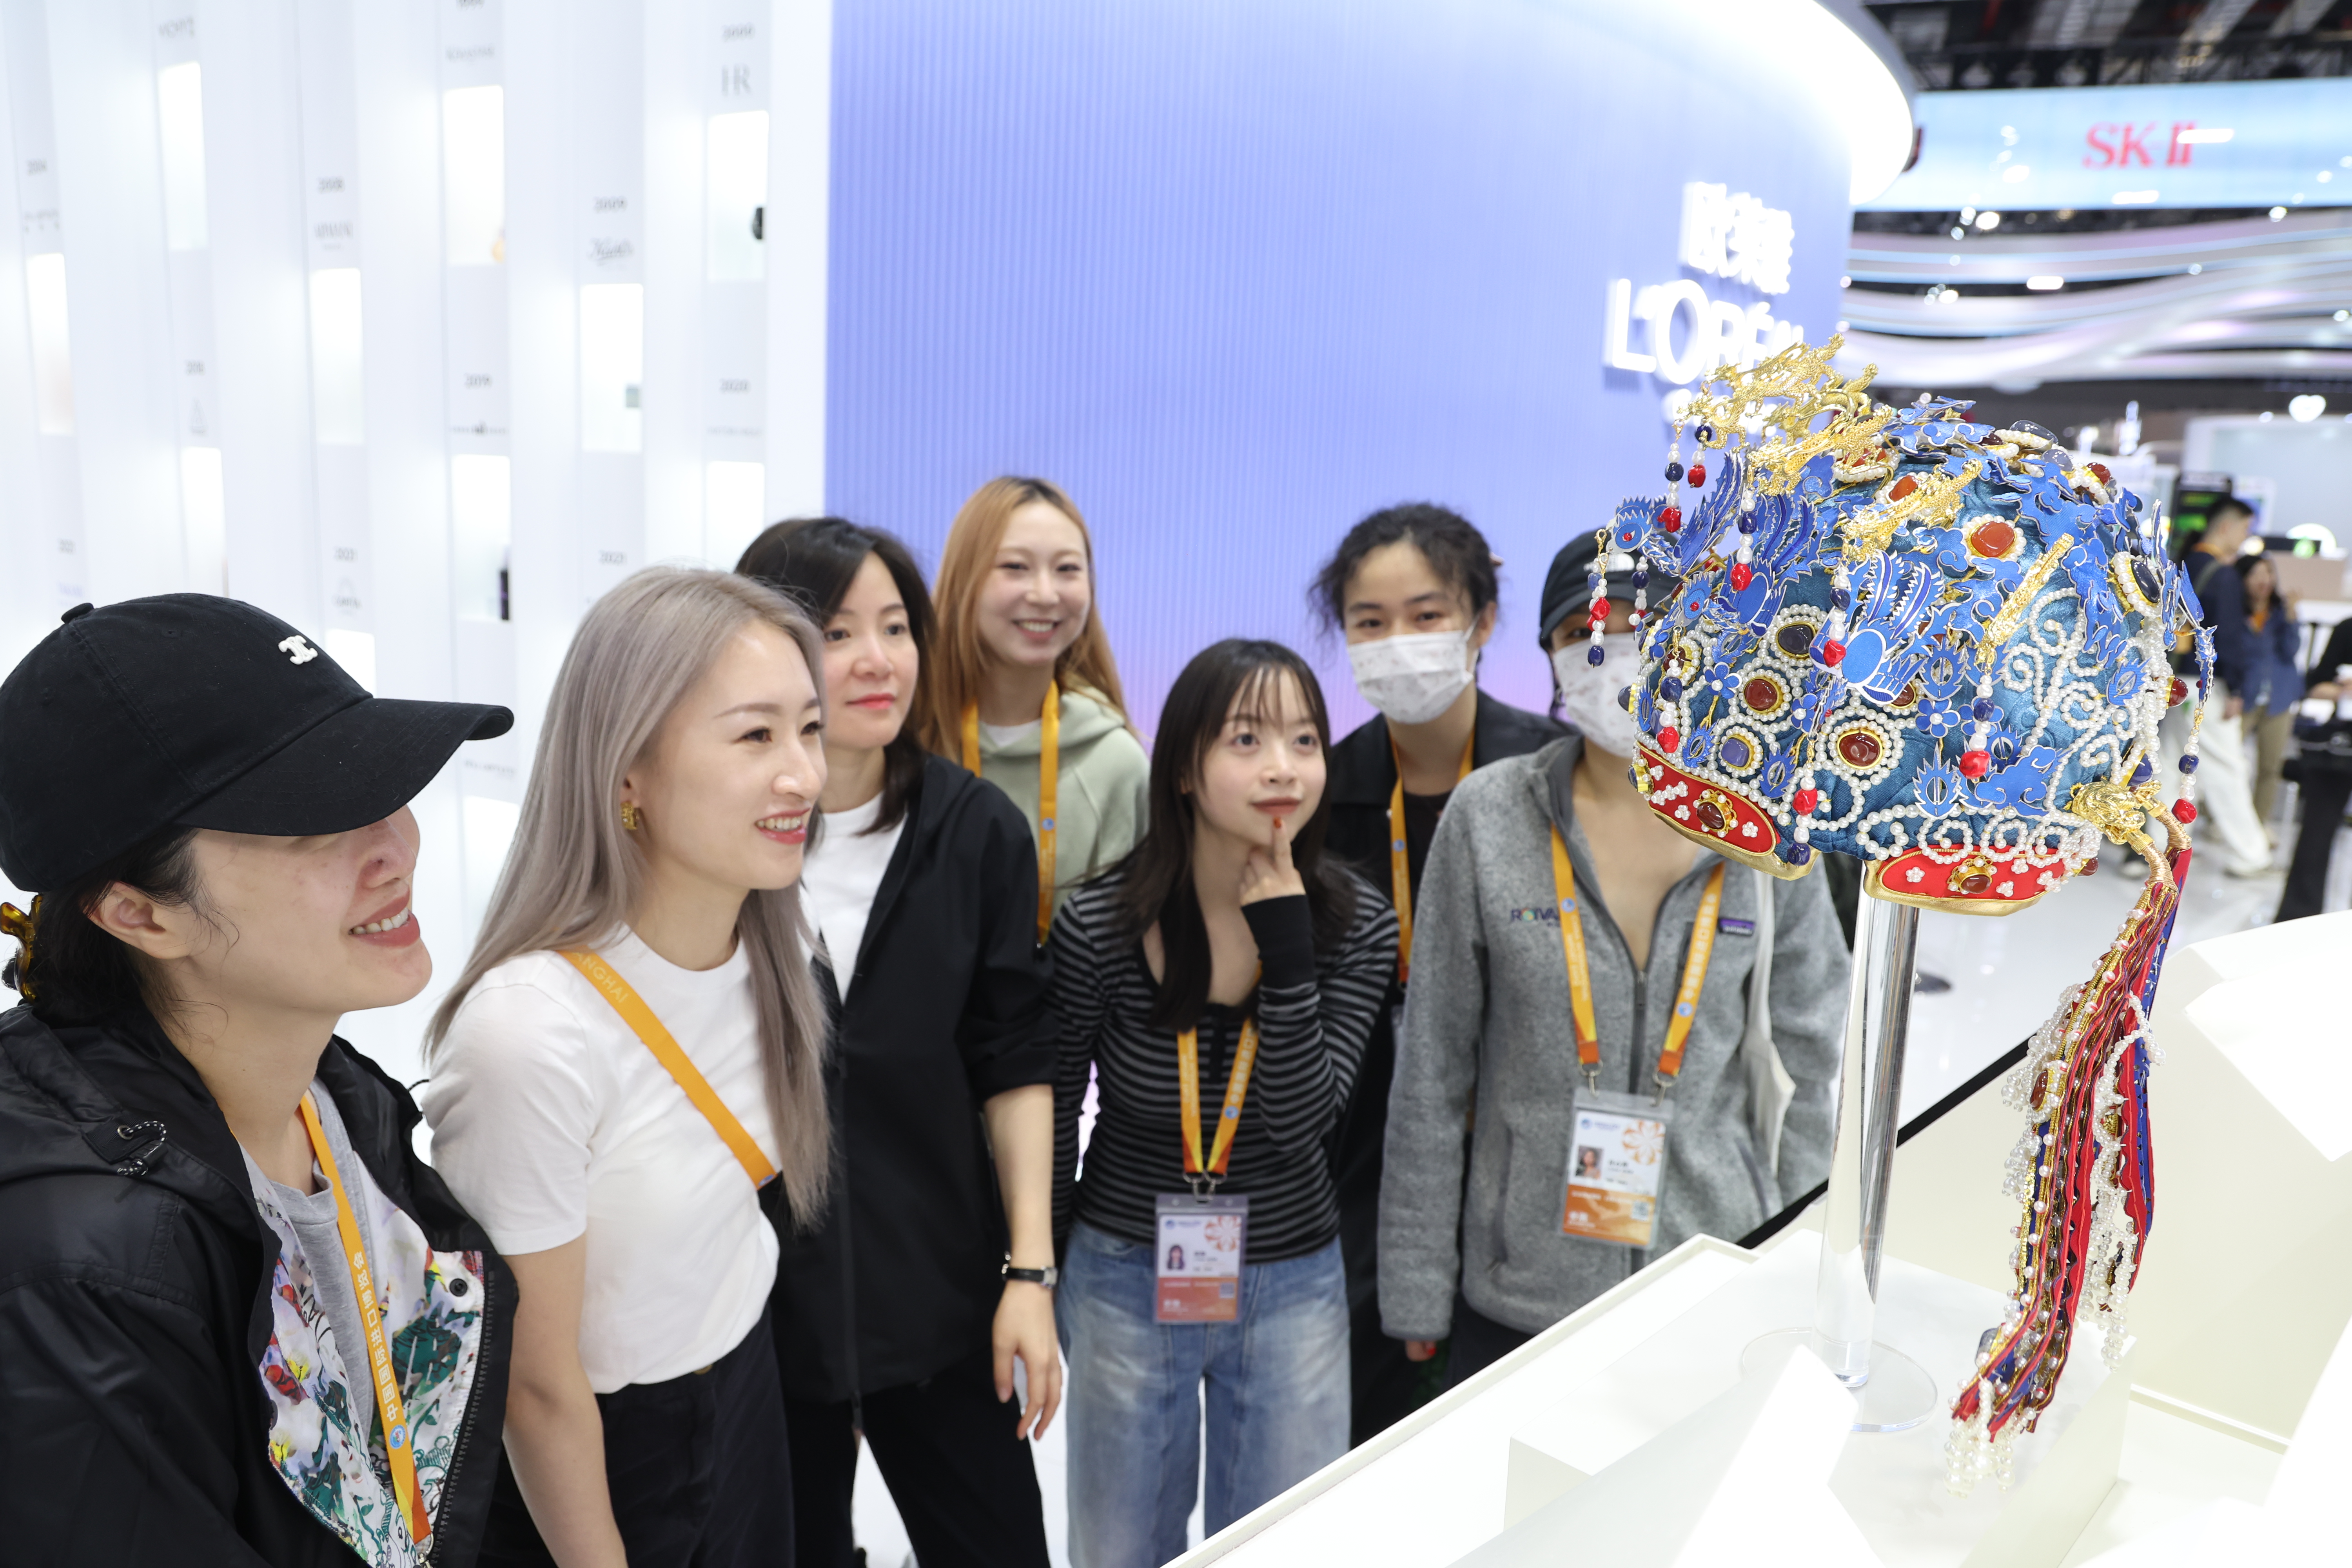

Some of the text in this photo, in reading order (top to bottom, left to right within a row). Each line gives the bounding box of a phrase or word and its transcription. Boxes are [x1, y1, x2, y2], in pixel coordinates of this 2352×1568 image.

[573, 952, 629, 1003] ANGHAI
[353, 1250, 398, 1422] 中国国际进口博览会
